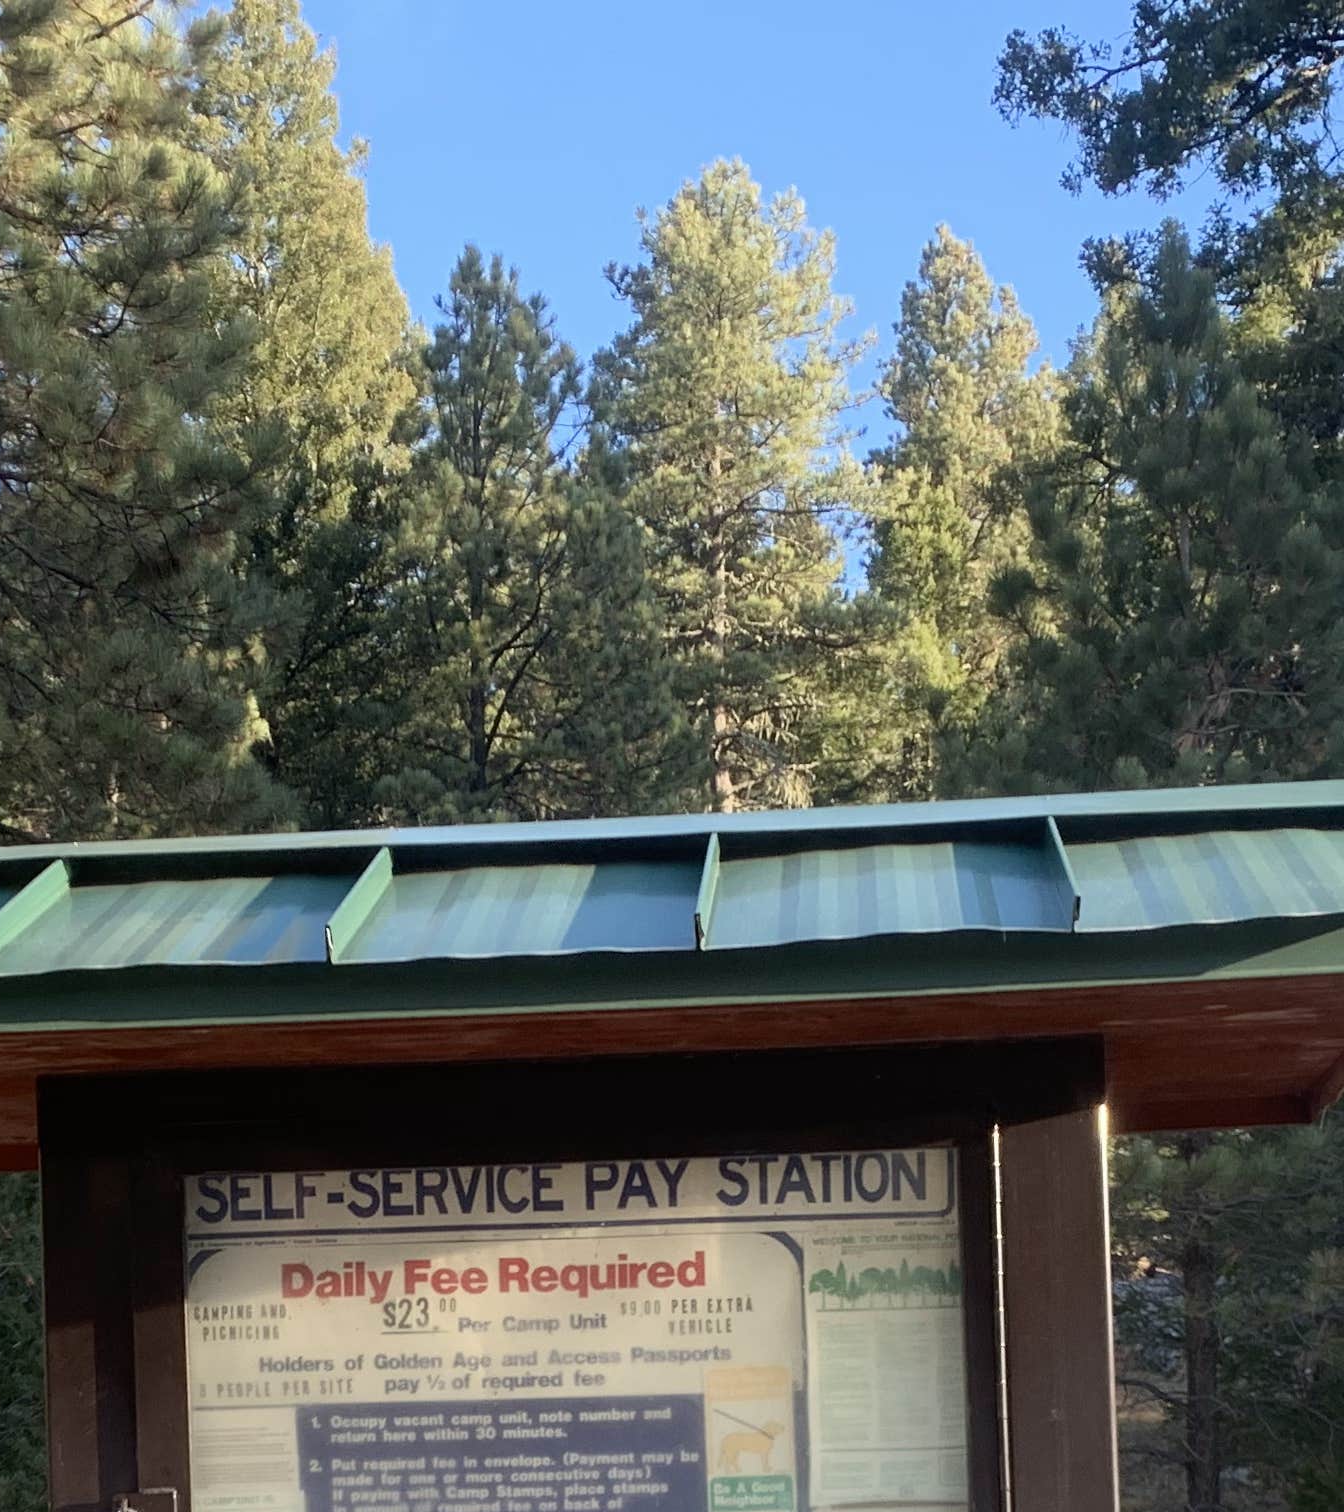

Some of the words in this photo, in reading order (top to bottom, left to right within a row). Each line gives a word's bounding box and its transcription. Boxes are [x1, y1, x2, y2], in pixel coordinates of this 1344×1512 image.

[196, 1165, 565, 1223] SELF-SERVICE
[585, 1159, 689, 1211] PAY
[715, 1151, 927, 1207] STATION
[281, 1261, 393, 1305] Daily
[403, 1259, 489, 1295] Fee
[498, 1250, 706, 1298] Required
[193, 1304, 253, 1322] CAMPING
[260, 1304, 287, 1320] AND
[671, 1298, 698, 1314] PER
[707, 1296, 753, 1312] EXTRA
[458, 1317, 491, 1333] Per
[502, 1315, 560, 1334] Camp
[569, 1313, 608, 1329] Unit
[668, 1318, 733, 1335] VEHICLE
[259, 1356, 334, 1373] Holders
[344, 1355, 363, 1371] of
[374, 1353, 442, 1371] Golden
[452, 1352, 492, 1372] Age
[502, 1350, 538, 1367] and
[548, 1349, 621, 1365] Access
[630, 1345, 732, 1365] Passports
[217, 1382, 271, 1398] PEOPLE
[283, 1380, 310, 1397] PER
[319, 1378, 353, 1395] SITE
[384, 1377, 420, 1395] pay
[452, 1375, 470, 1390] of
[481, 1371, 563, 1391] required
[574, 1369, 605, 1386] fee
[311, 1416, 322, 1429] 1.
[330, 1415, 387, 1430] Occupy
[394, 1414, 444, 1427] vacant
[451, 1414, 492, 1428] camp
[499, 1411, 533, 1425] unit,
[539, 1410, 573, 1423] note
[579, 1408, 636, 1422] number
[643, 1408, 672, 1420] and
[331, 1430, 376, 1443] return
[383, 1430, 417, 1442] here
[424, 1427, 469, 1441] within
[475, 1427, 496, 1440] 30
[502, 1426, 568, 1439] minutes.
[309, 1459, 323, 1473] 2.
[331, 1459, 356, 1472] Put
[363, 1457, 426, 1473] required
[432, 1457, 456, 1470] fee
[463, 1456, 478, 1469] in
[484, 1454, 556, 1469] envelope.
[562, 1451, 635, 1467] (Payment
[641, 1453, 674, 1466] may
[680, 1450, 700, 1463] be
[332, 1474, 374, 1487] made
[381, 1473, 401, 1486] for
[409, 1474, 436, 1485] one
[443, 1473, 459, 1485] or
[466, 1472, 503, 1484] more
[511, 1468, 600, 1482] consecutive
[607, 1466, 652, 1481] days)
[445, 1486, 489, 1501] Camp
[564, 1483, 606, 1497] place
[612, 1482, 669, 1495] stamps
[564, 1498, 601, 1511] back
[607, 1497, 624, 1510] of
